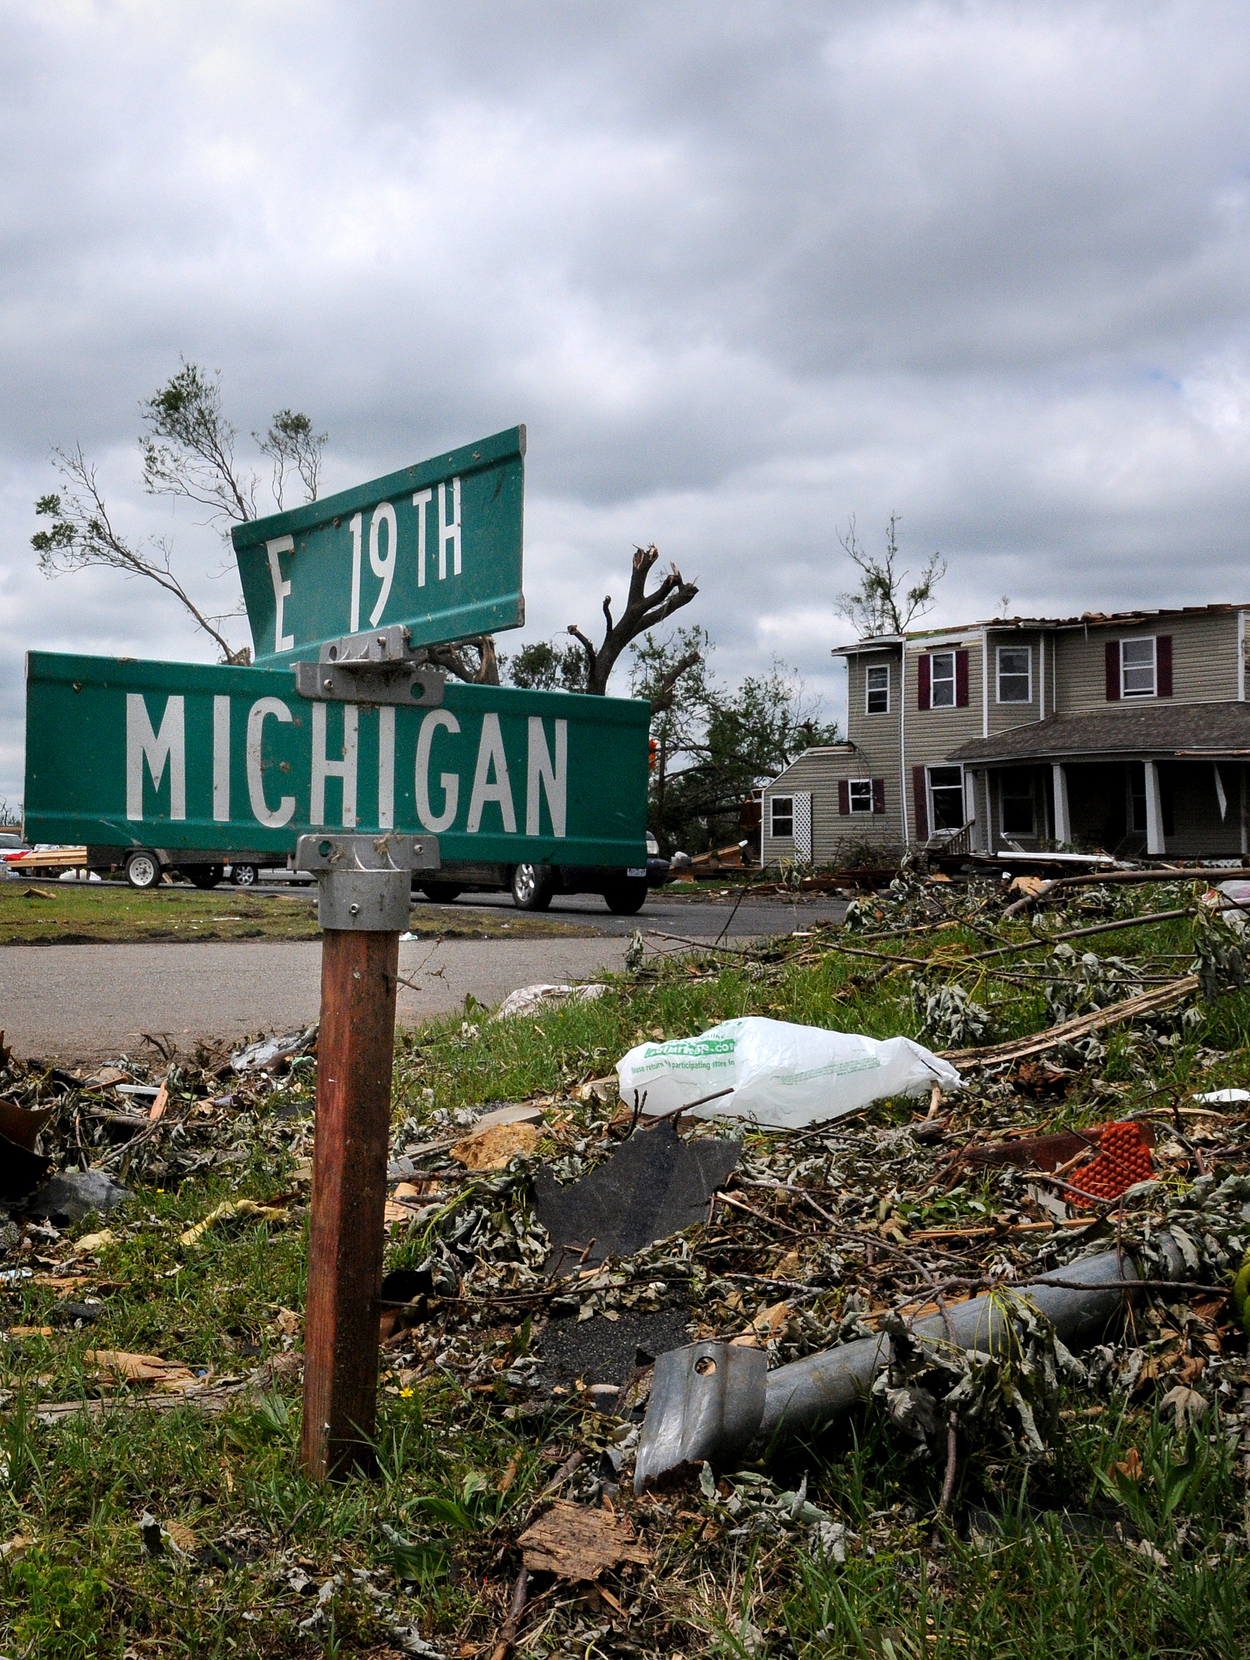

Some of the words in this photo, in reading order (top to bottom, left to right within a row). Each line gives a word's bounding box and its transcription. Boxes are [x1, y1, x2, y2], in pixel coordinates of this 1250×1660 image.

[267, 534, 295, 653] E
[126, 693, 569, 838] MICHIGAN
[646, 1062, 664, 1072] return
[672, 1060, 711, 1071] participating
[712, 1060, 727, 1068] store
